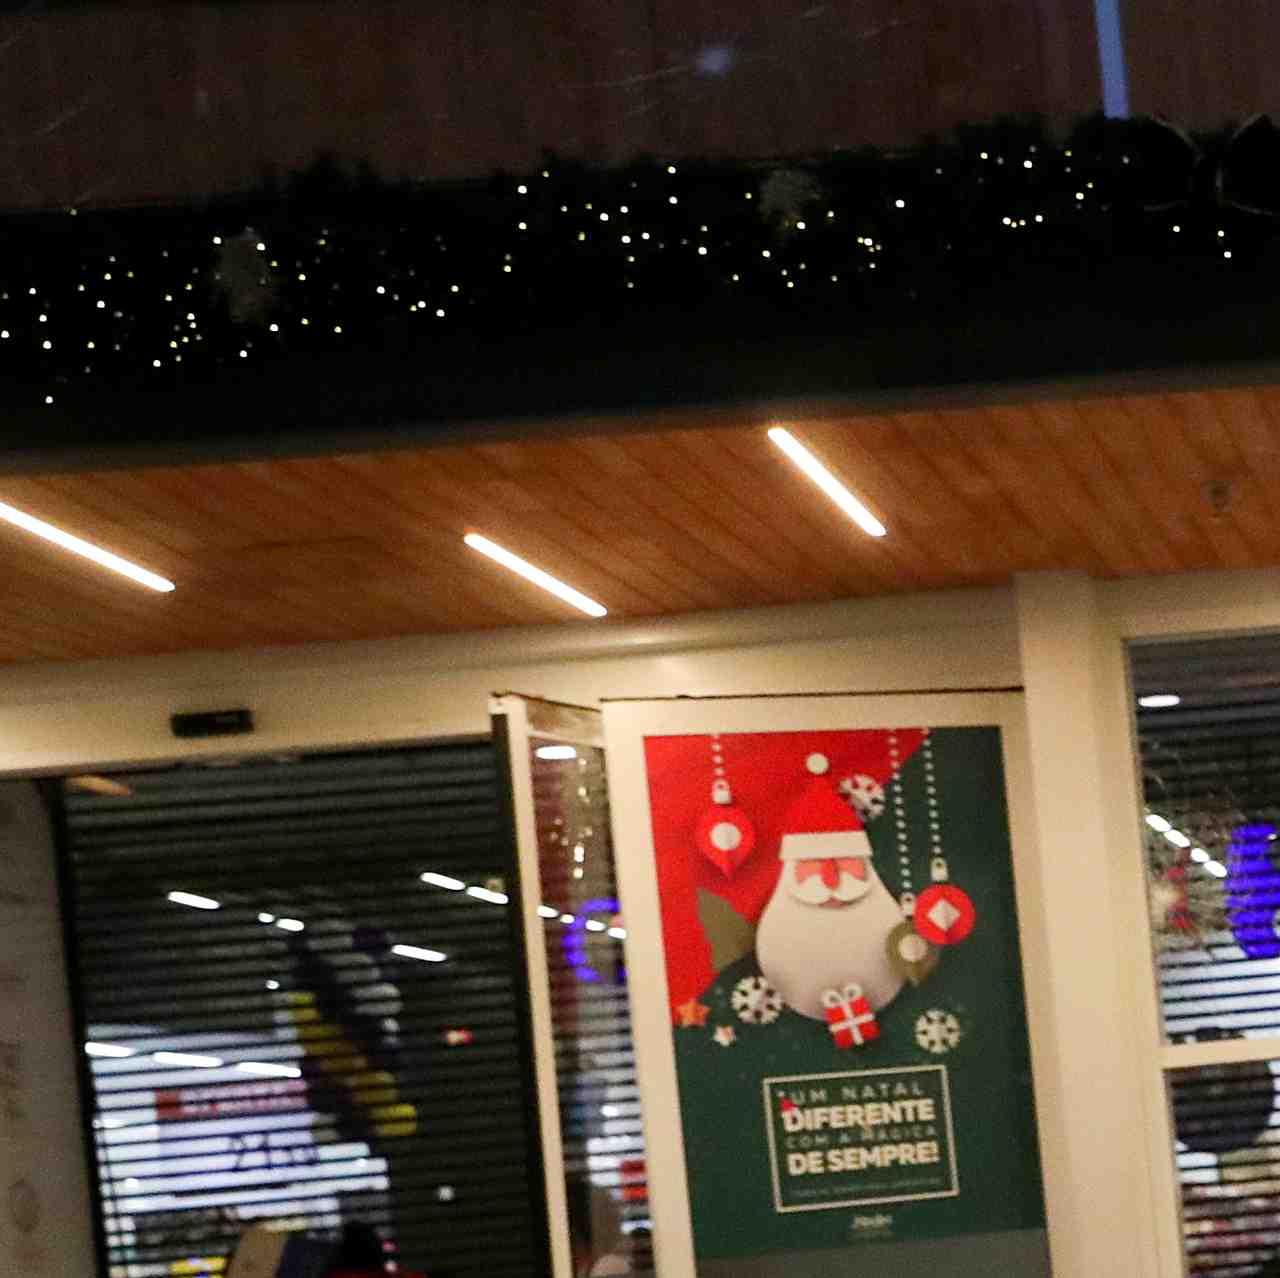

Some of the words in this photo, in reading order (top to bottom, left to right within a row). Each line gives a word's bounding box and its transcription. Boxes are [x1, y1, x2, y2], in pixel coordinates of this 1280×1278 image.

[841, 1081, 925, 1100] NATAL
[781, 1098, 937, 1133] DIFERENTE
[787, 1150, 825, 1177] DE
